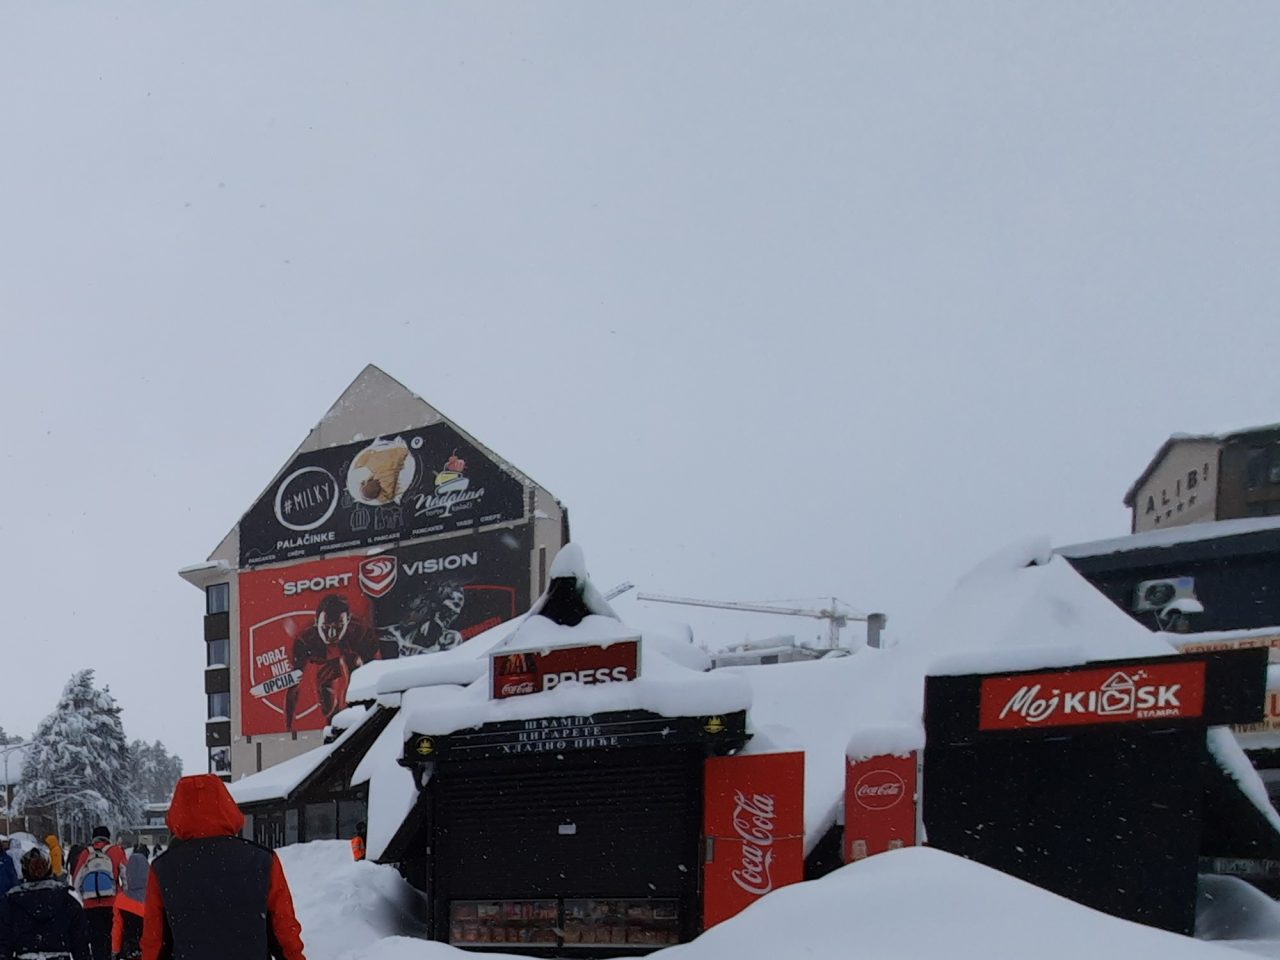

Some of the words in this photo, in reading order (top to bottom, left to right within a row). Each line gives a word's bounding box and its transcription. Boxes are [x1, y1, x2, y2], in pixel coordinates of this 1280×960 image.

[283, 482, 330, 515] #MILKY
[276, 531, 336, 550] PALAČINKE
[283, 572, 353, 596] SPORT
[402, 550, 479, 577] VISION
[256, 645, 287, 668] PORAZ
[271, 661, 292, 678] NIJE
[262, 673, 295, 694] OPCIJA
[998, 684, 1061, 722] Moj
[518, 726, 602, 741] ЦИГАРЕТЕ
[503, 741, 566, 753] ХЛАДНО
[731, 788, 775, 895] Coca-Cola
